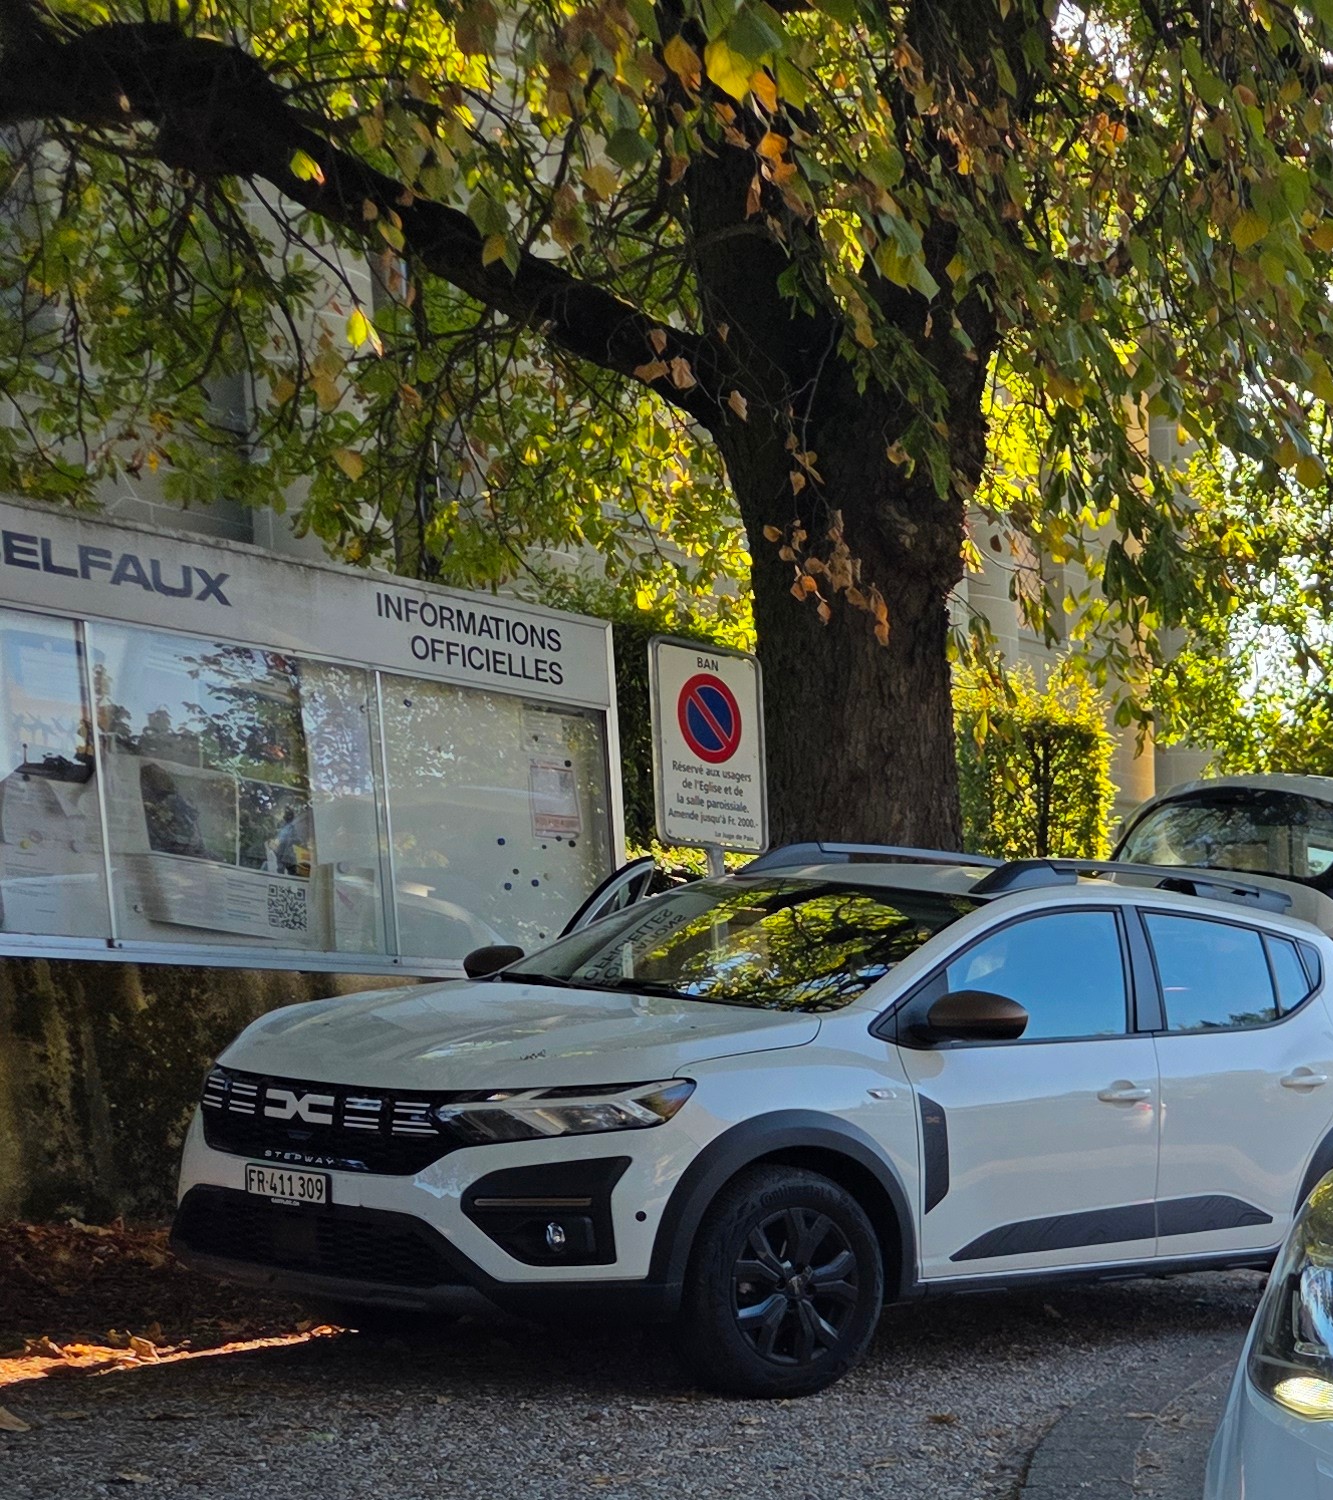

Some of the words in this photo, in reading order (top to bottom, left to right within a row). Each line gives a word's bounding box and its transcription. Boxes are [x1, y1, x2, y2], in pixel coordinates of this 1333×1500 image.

[1, 529, 233, 607] ELFAUX
[376, 591, 562, 652] INFORMATIONS
[410, 634, 564, 685] OFFICIELLES
[696, 656, 719, 672] BAN
[672, 760, 704, 775] Réservé
[705, 767, 721, 778] aux
[722, 770, 752, 783] usagers
[682, 778, 693, 789] de
[723, 786, 732, 796] et
[733, 786, 744, 797] de
[686, 795, 704, 807] salle
[706, 800, 750, 814] paroissiale.
[668, 807, 699, 821] Amende
[700, 811, 727, 825] jusqu'à
[727, 815, 736, 826] Fr.
[264, 1149, 334, 1165] STEPWAY
